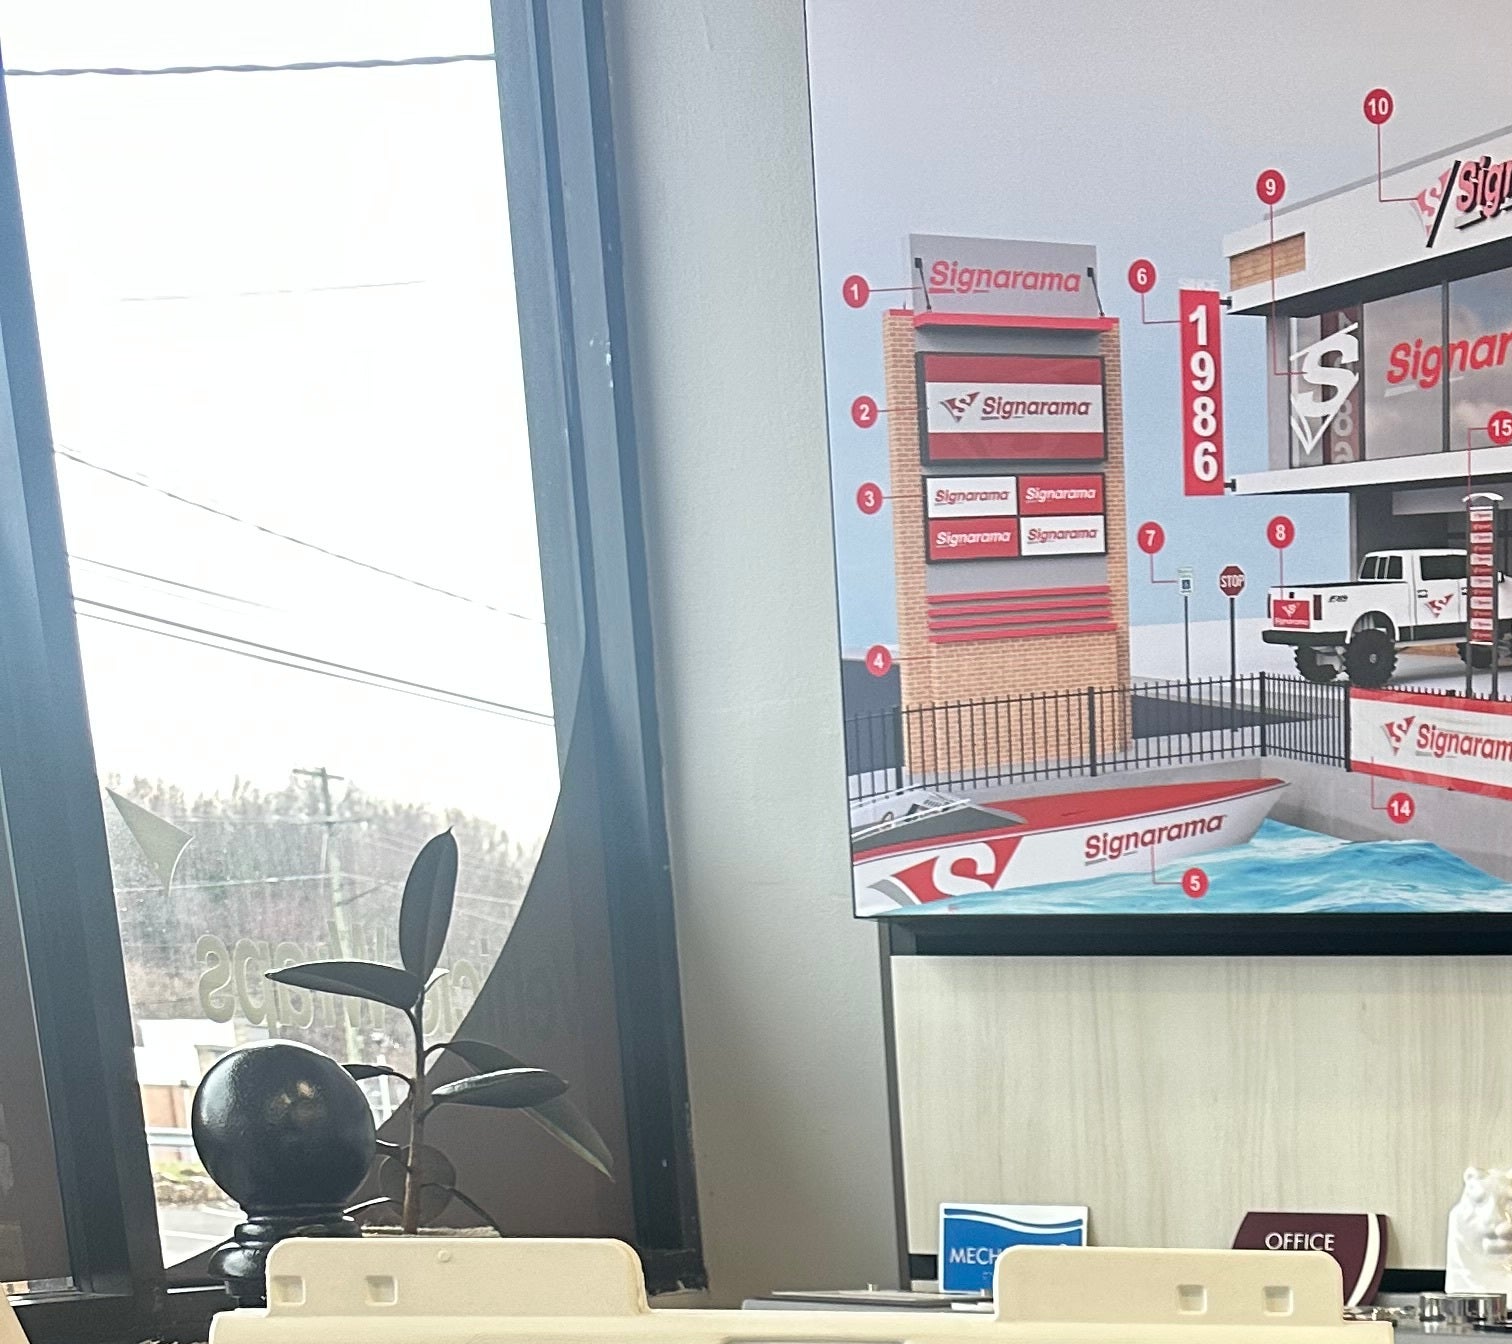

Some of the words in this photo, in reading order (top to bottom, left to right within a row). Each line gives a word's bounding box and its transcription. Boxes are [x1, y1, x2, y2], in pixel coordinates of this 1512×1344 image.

[1368, 97, 1389, 116] 10
[1265, 178, 1276, 196] 9
[928, 260, 1081, 294] Signarama
[1136, 267, 1148, 285] 6
[850, 283, 859, 301] 1
[1188, 304, 1218, 482] 1986
[859, 403, 870, 421] 2
[981, 396, 1092, 420] Signarama
[1491, 419, 1512, 437] 15
[864, 490, 875, 507] 3
[935, 489, 1009, 504] Signarama
[1025, 487, 1096, 503] Signarama
[936, 531, 1011, 548] Signarama
[1027, 528, 1098, 544] Signarama
[1145, 529, 1156, 546] 7
[1275, 523, 1286, 541] 8
[1220, 574, 1244, 588] STOP
[873, 653, 884, 669] 4
[1390, 800, 1411, 817] 14
[1085, 813, 1225, 860] Signarama
[1190, 875, 1201, 892] 5
[1265, 1232, 1335, 1251] OFFICE
[949, 1246, 1001, 1265] MECH
